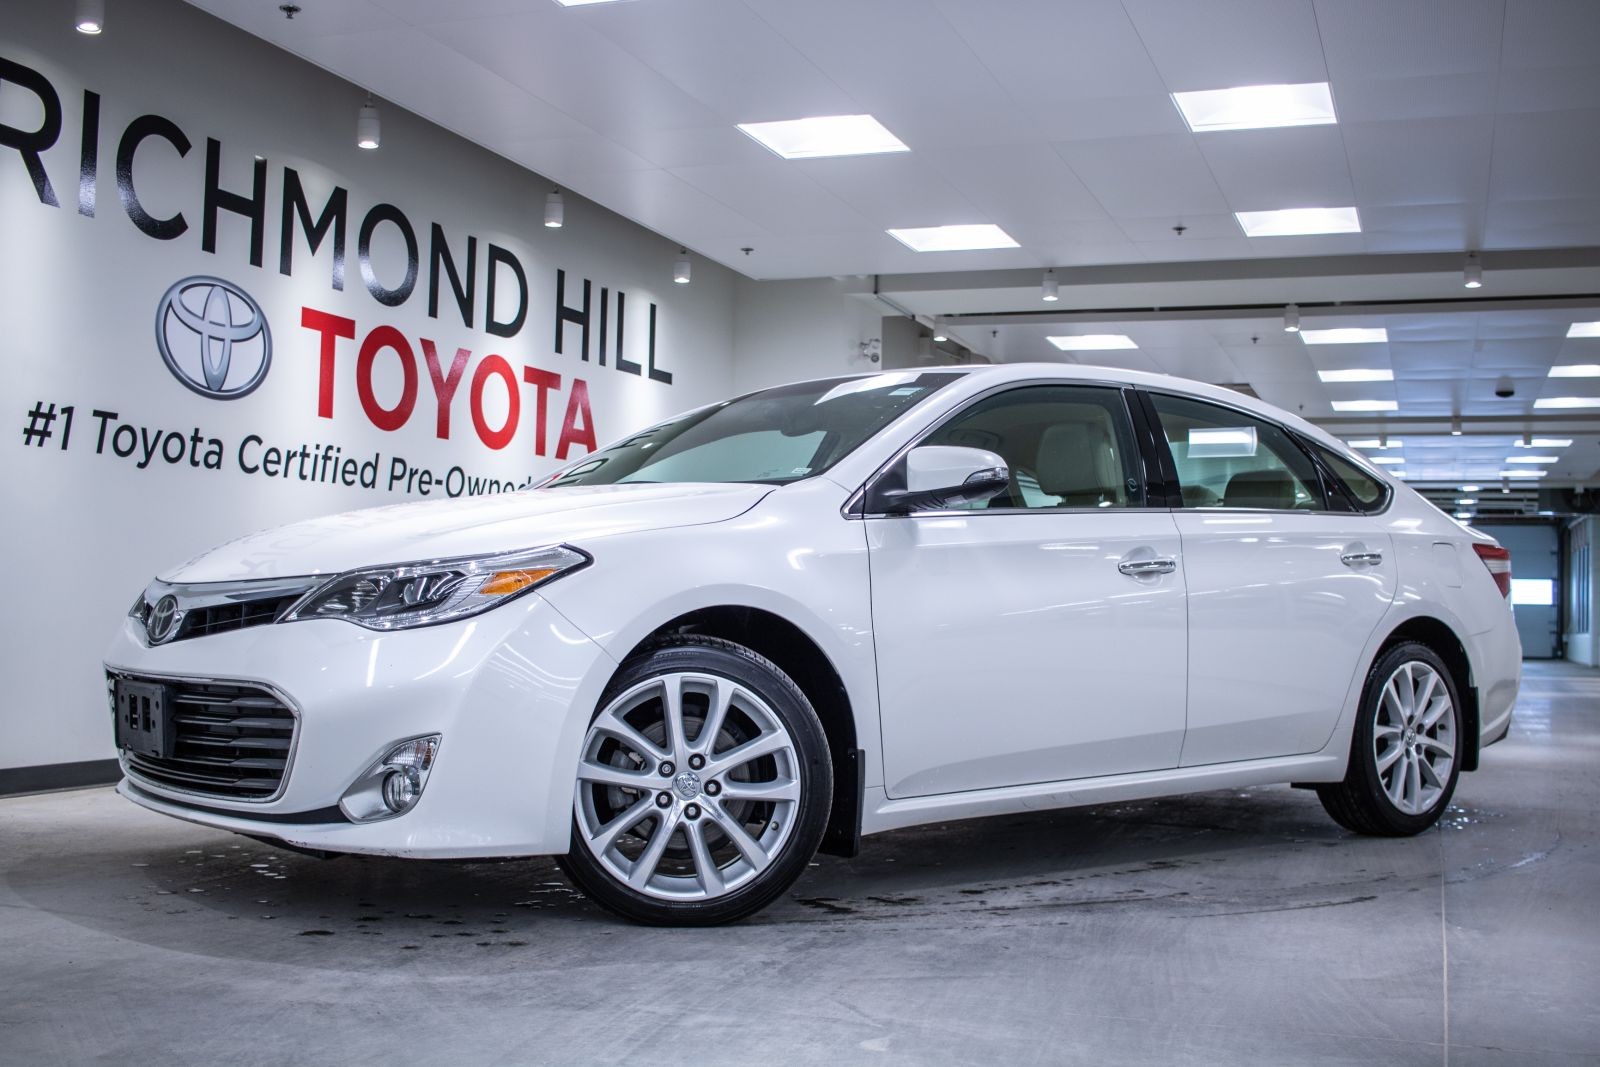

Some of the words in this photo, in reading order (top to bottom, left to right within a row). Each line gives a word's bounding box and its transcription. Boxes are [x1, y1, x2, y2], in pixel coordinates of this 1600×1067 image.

[0, 57, 529, 338] RICHMOND
[555, 269, 673, 385] HILL
[23, 401, 75, 451] #1
[92, 409, 224, 470] Toyota
[238, 434, 378, 490] Certified
[388, 457, 532, 498] Pre-Own
[301, 307, 598, 461] TOYOTA
